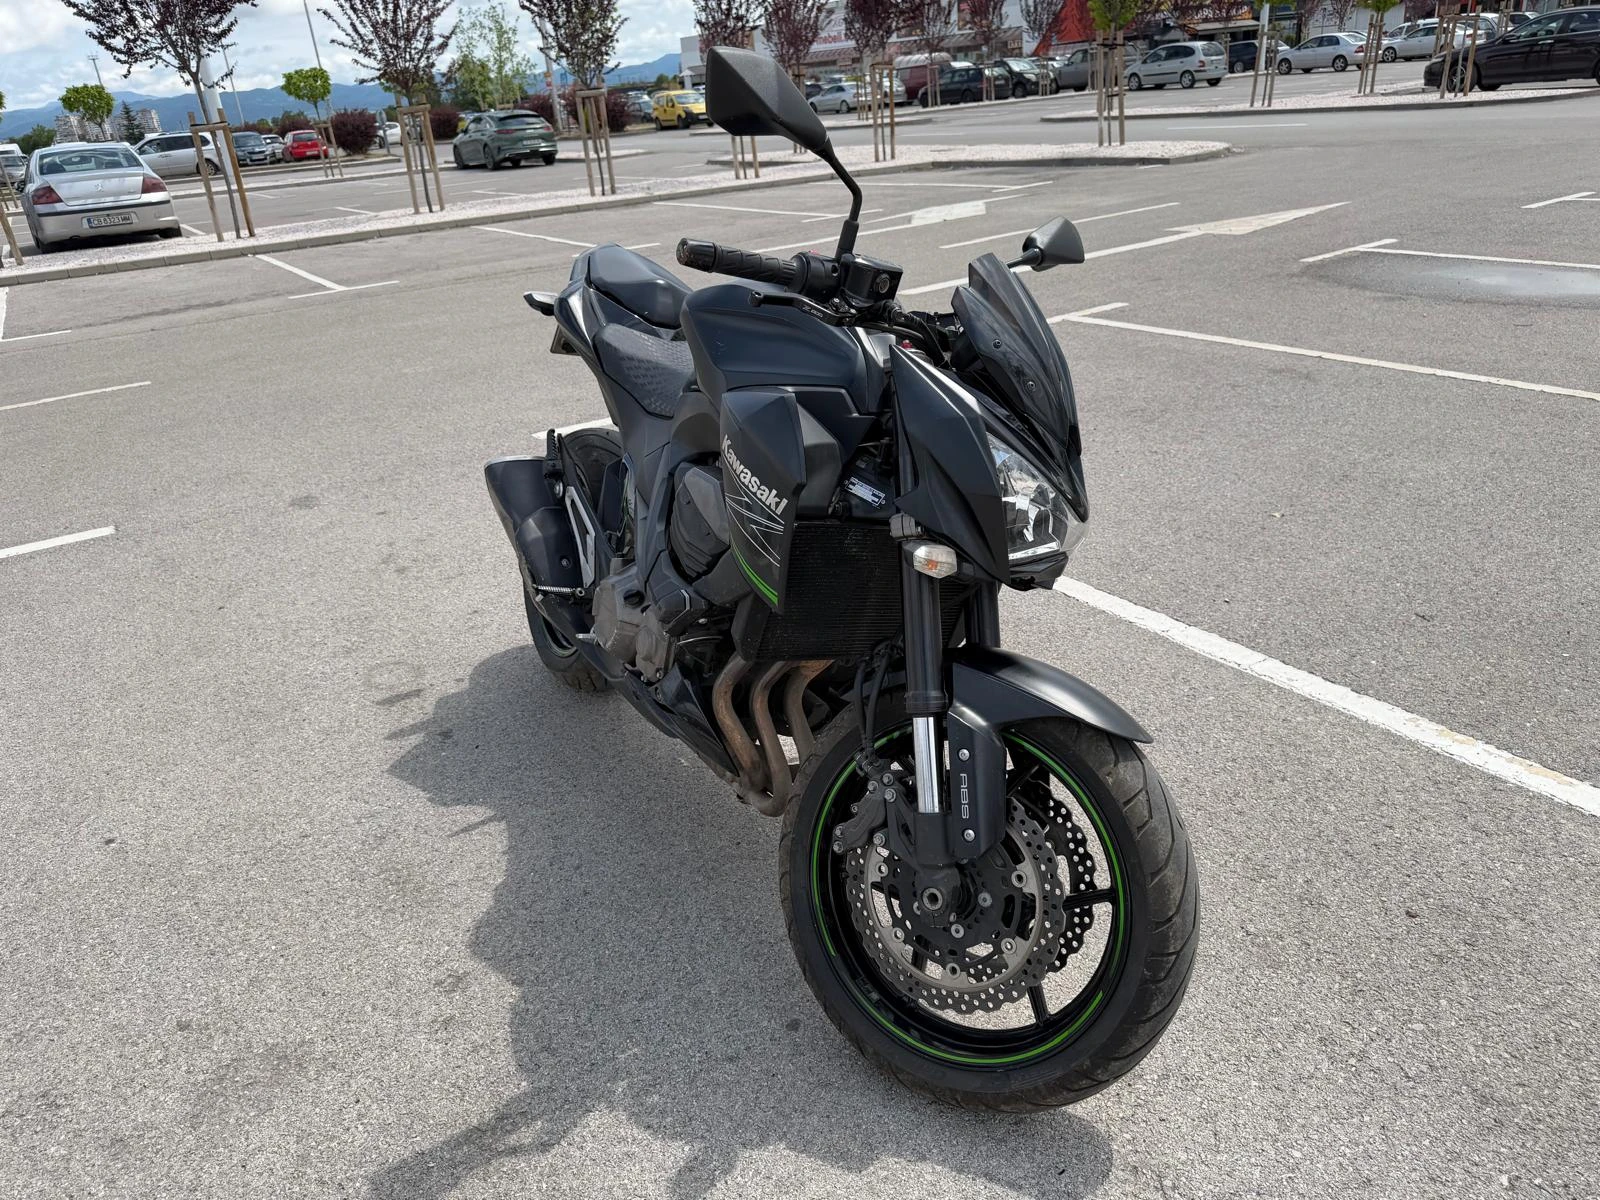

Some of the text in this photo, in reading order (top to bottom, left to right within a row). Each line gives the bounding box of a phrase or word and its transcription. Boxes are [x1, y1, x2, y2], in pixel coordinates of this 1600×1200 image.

[93, 218, 102, 226] CB
[103, 216, 120, 225] 8323
[722, 433, 788, 515] Kawasaki
[960, 773, 970, 819] ABS
